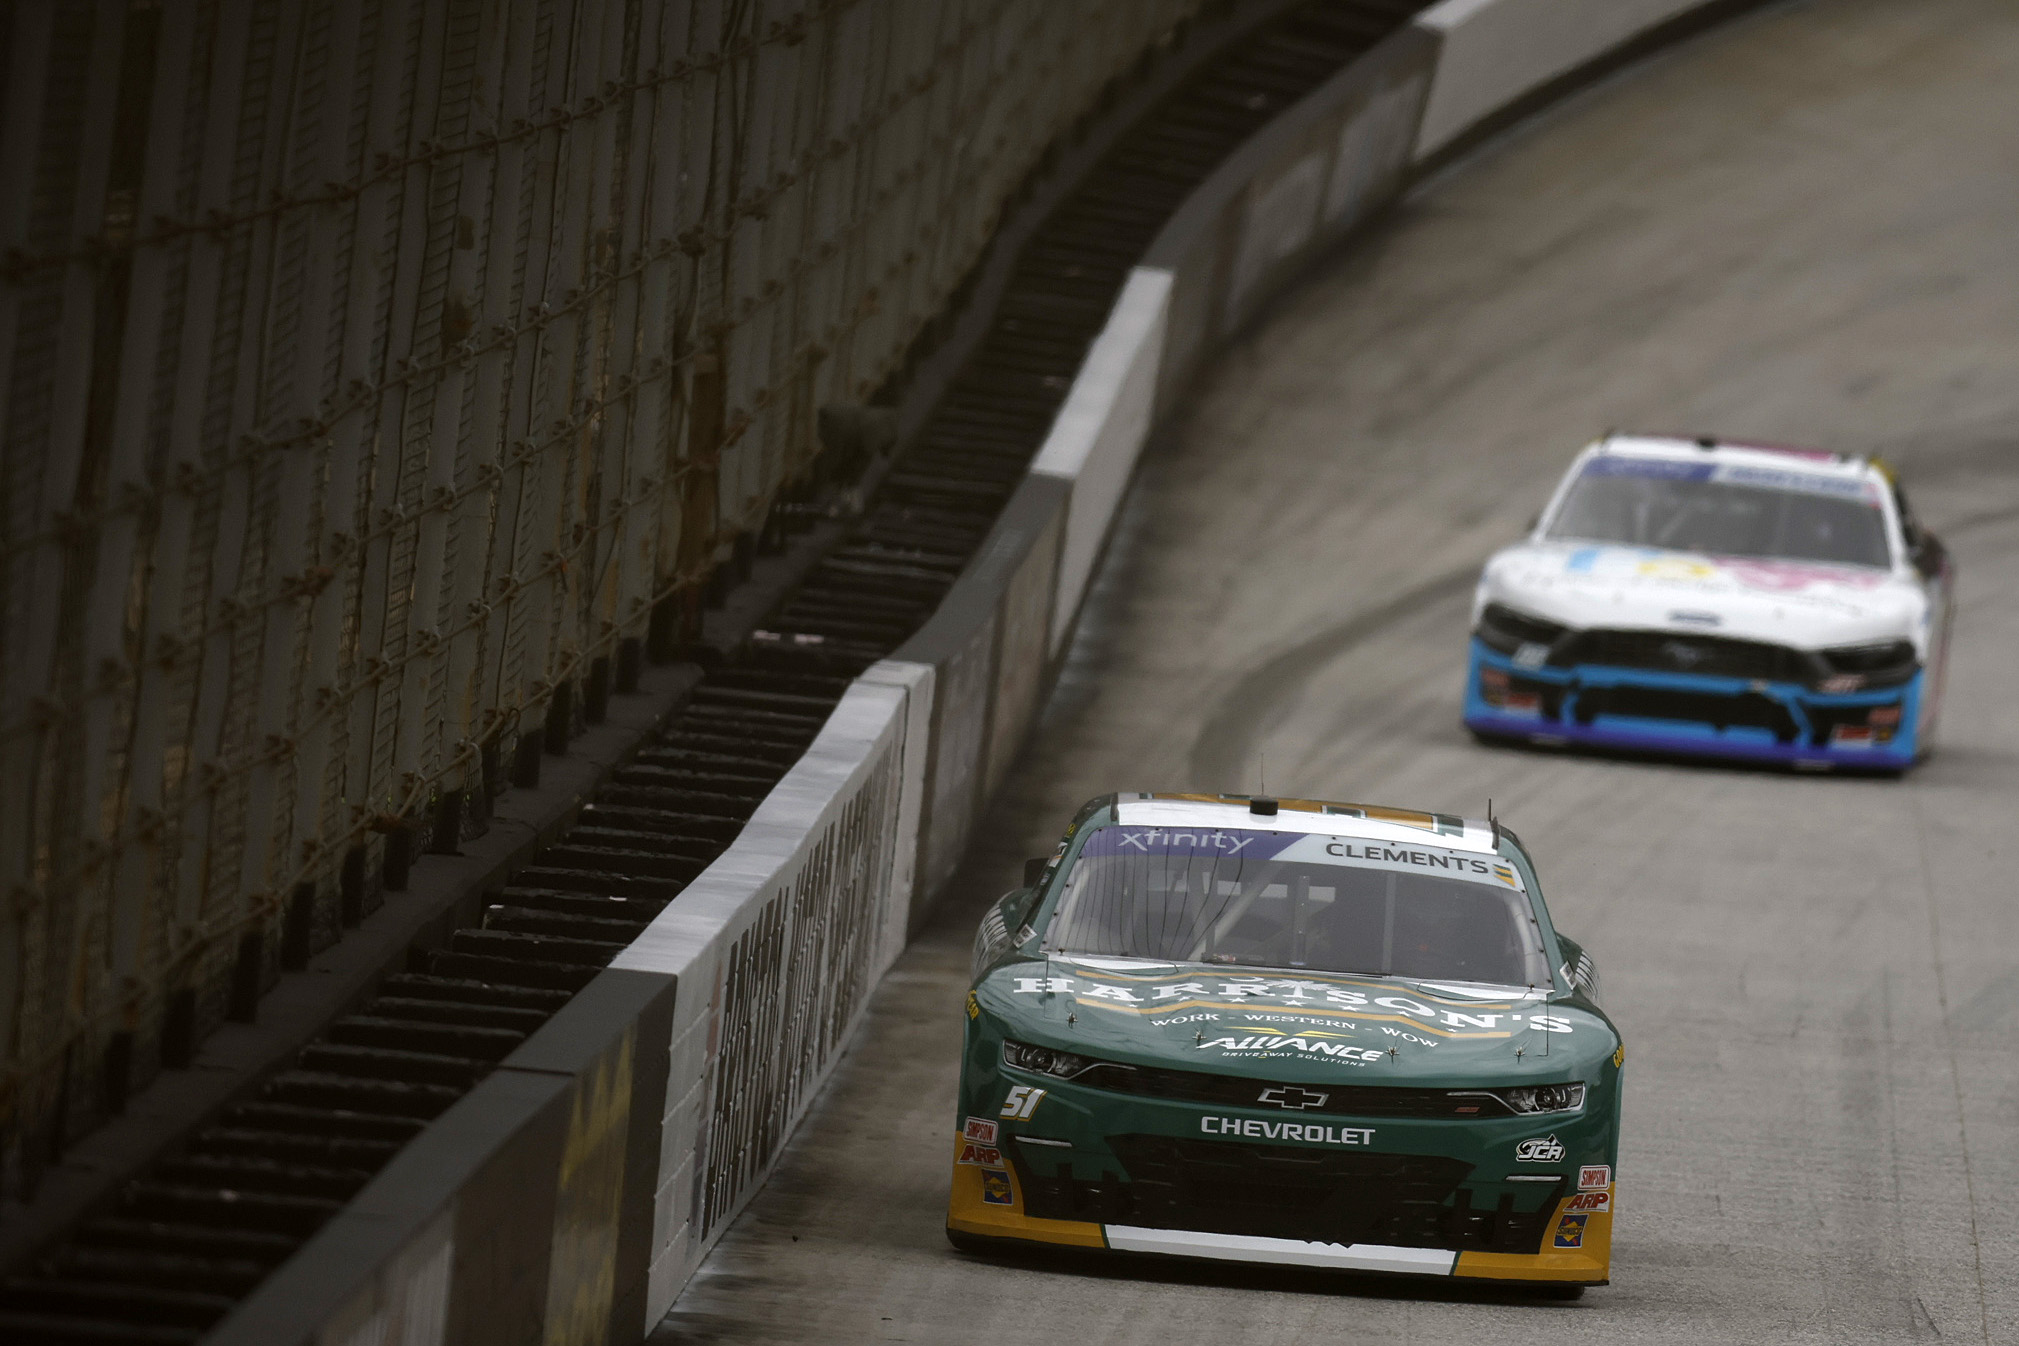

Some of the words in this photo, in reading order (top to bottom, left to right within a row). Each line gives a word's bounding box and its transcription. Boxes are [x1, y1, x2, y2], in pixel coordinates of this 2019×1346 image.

[1118, 829, 1254, 854] xfinity
[1325, 843, 1489, 875] CLEMENTS
[1013, 977, 1574, 1034] HARRISON'S
[1151, 1013, 1220, 1027] WORK
[1244, 1014, 1356, 1031] WESTERN
[1380, 1026, 1440, 1048] WOW
[1196, 1035, 1384, 1062] ALLIANCE
[1221, 1051, 1292, 1059] DRIVEAWAY
[1296, 1052, 1366, 1067] SOLUTIONS
[1000, 1085, 1048, 1122] 51
[966, 1121, 995, 1142] SIMPSON
[1201, 1116, 1376, 1145] CHEVROLET
[960, 1144, 1001, 1165] ARP
[1581, 1169, 1607, 1187] SIMPSON
[1566, 1193, 1609, 1209] ARP
